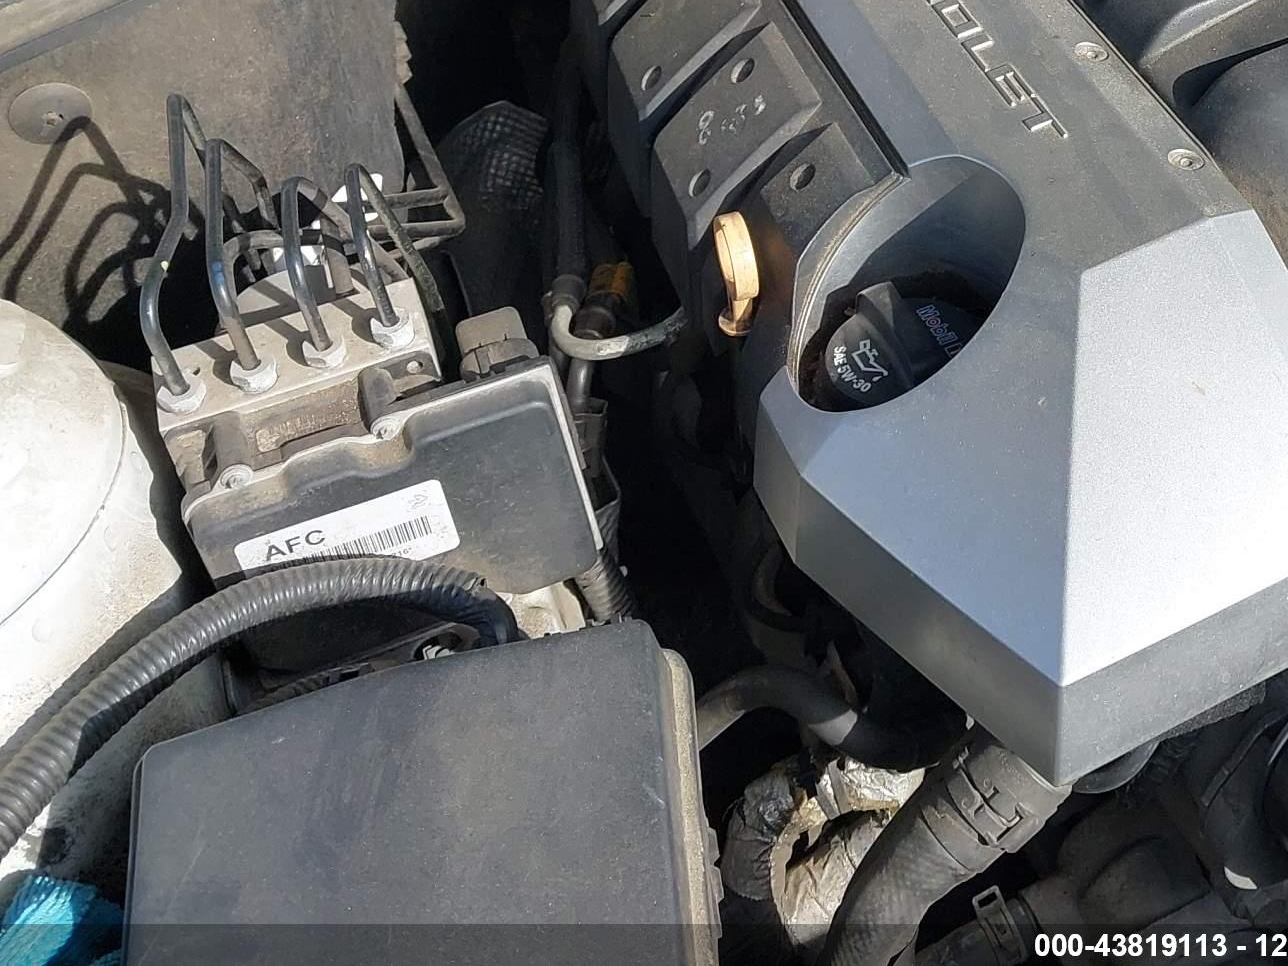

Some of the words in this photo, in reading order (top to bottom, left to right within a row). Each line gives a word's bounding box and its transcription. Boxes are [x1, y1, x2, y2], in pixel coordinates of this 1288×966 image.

[916, 304, 959, 346] Mobil
[833, 345, 848, 366] SAE
[837, 364, 872, 393] 5W-30
[265, 530, 326, 562] AFC
